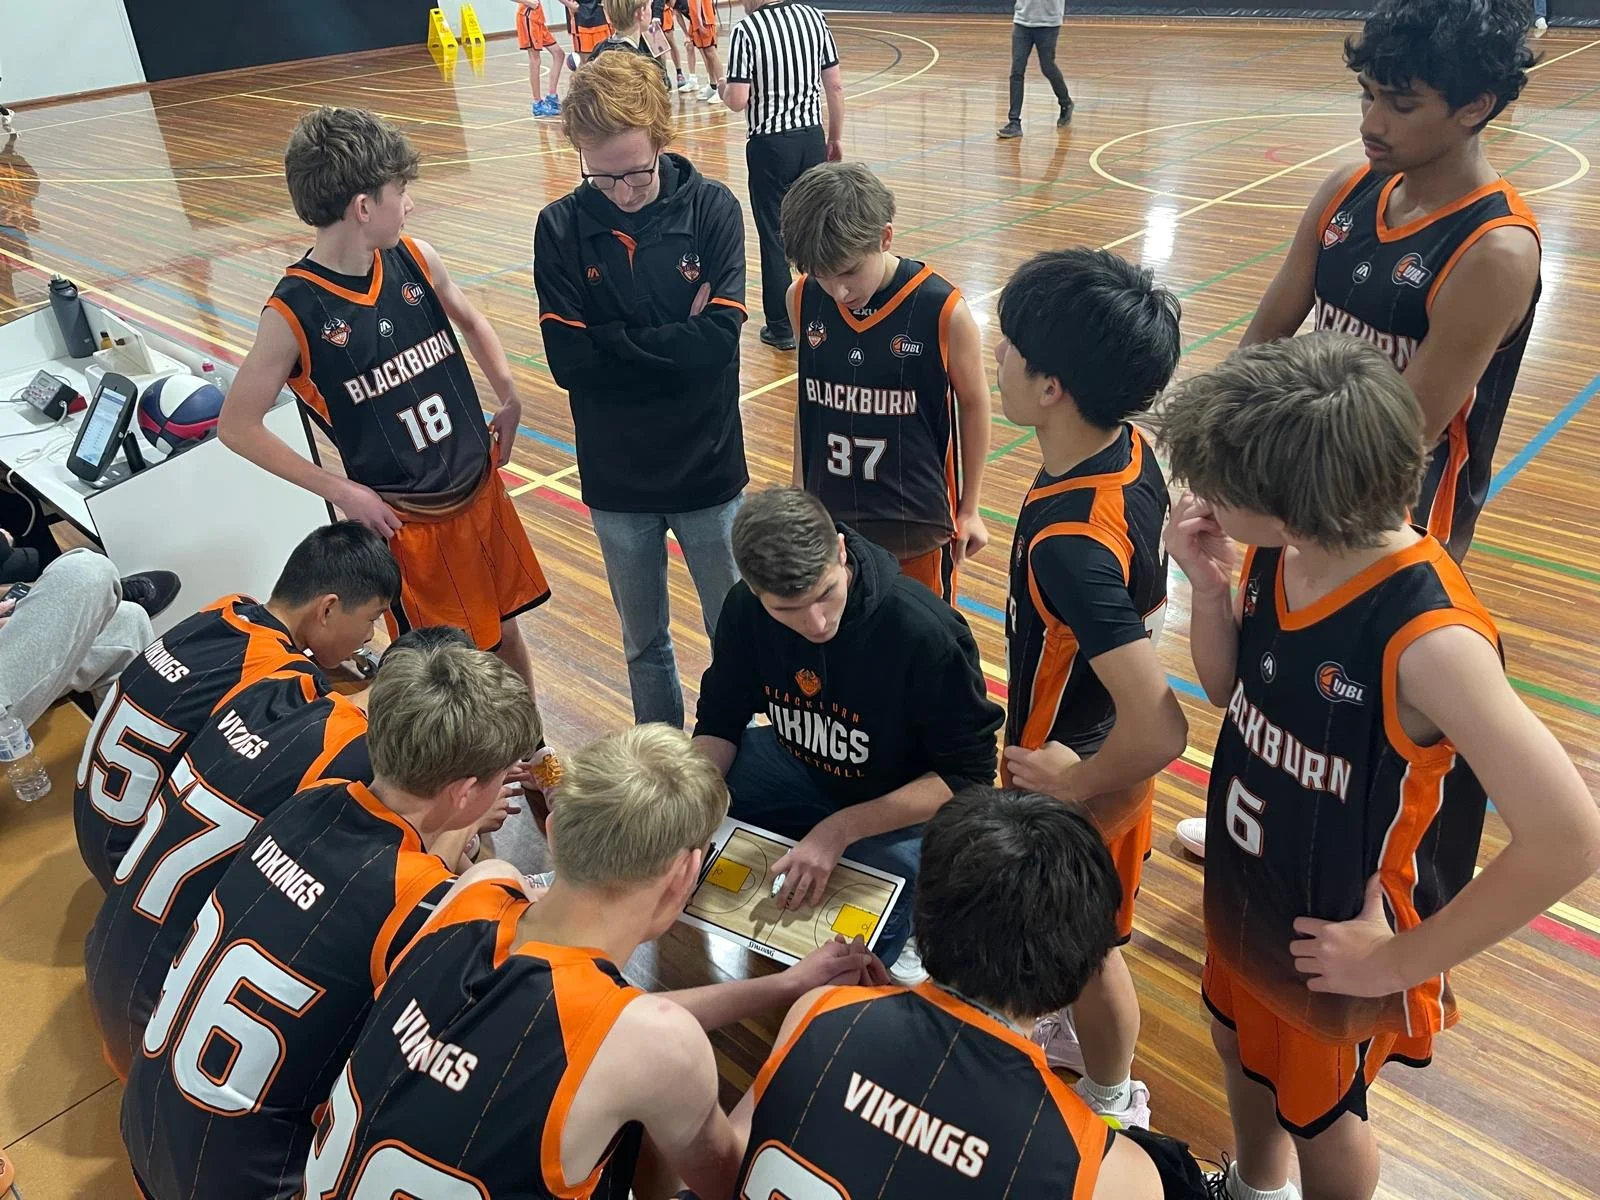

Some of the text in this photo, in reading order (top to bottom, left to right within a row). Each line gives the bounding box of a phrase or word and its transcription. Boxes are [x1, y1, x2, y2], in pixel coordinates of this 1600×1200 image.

[342, 330, 456, 406] BLACKBURN
[901, 342, 920, 354] VJBL
[396, 393, 453, 452] 18
[805, 377, 918, 415] BLACKBURN
[827, 433, 887, 481] 37
[1333, 678, 1365, 701] VJBL
[1228, 677, 1353, 805] ACKBURN
[1225, 775, 1266, 857] 6
[250, 834, 325, 911] VIKINGS
[843, 1071, 990, 1178] VIKINGS
